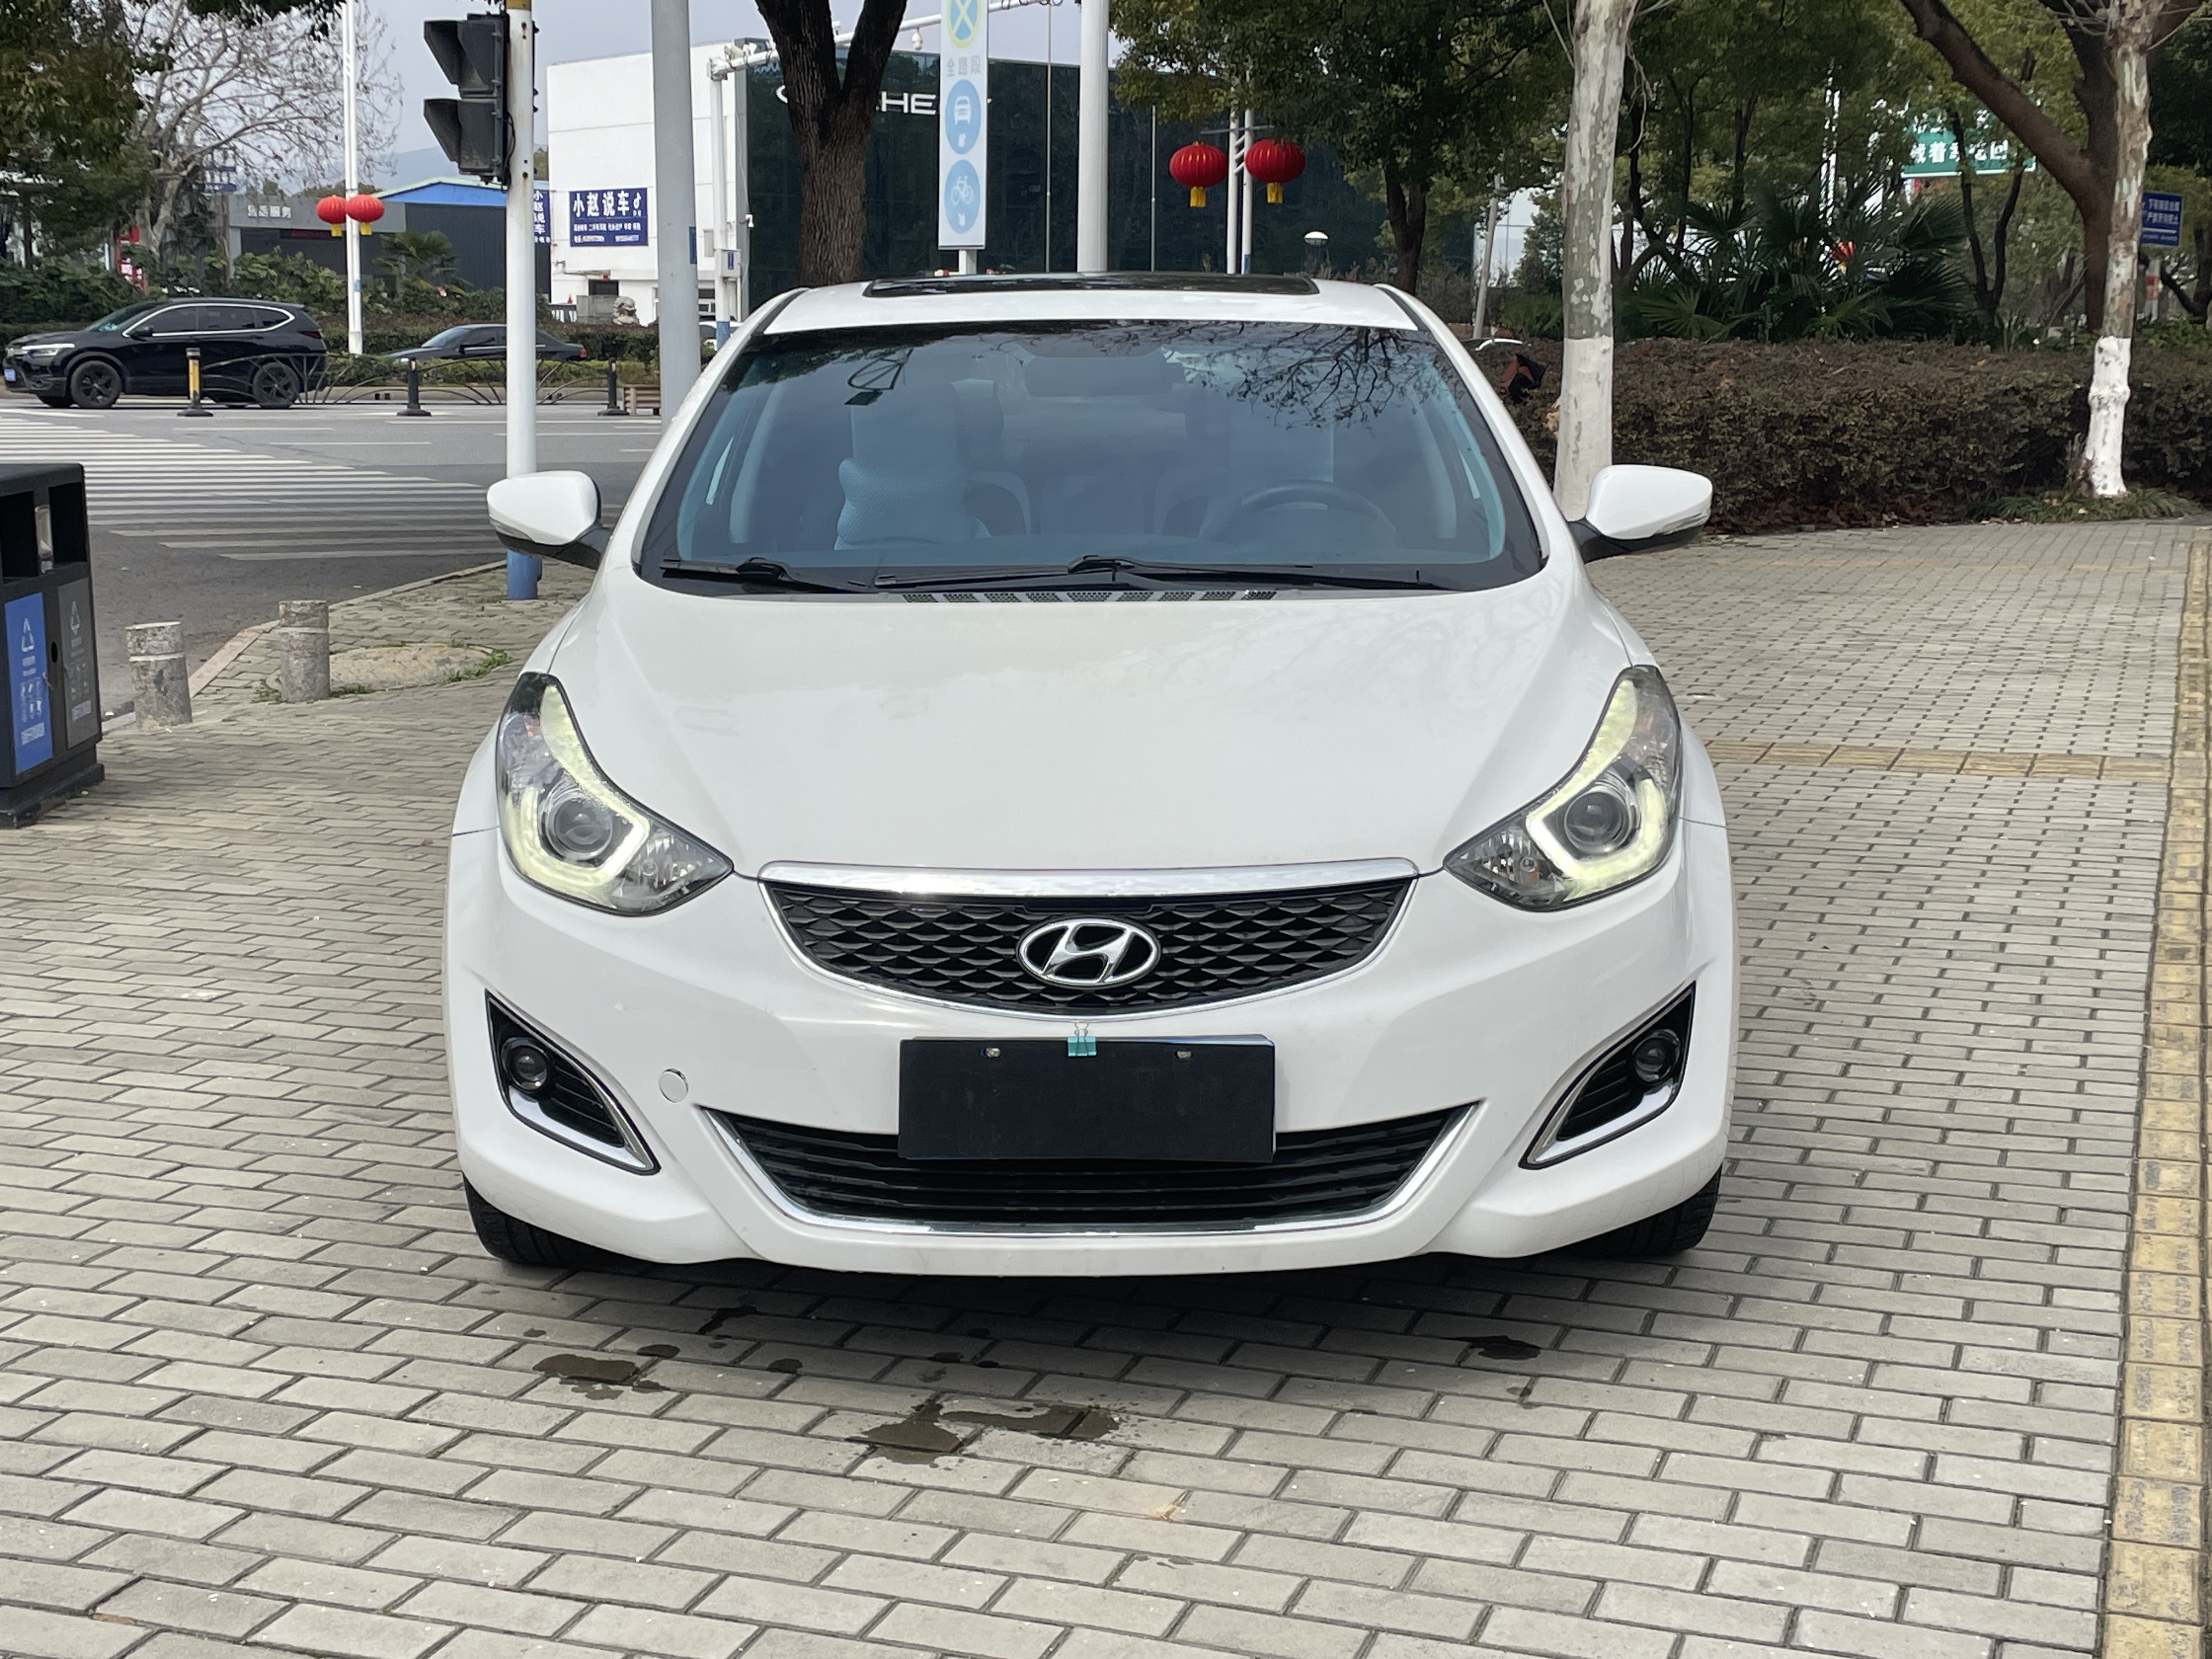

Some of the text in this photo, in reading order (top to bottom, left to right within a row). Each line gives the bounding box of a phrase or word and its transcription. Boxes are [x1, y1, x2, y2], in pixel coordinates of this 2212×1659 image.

[946, 55, 981, 77] 全路段
[573, 190, 630, 218] 小赵说车
